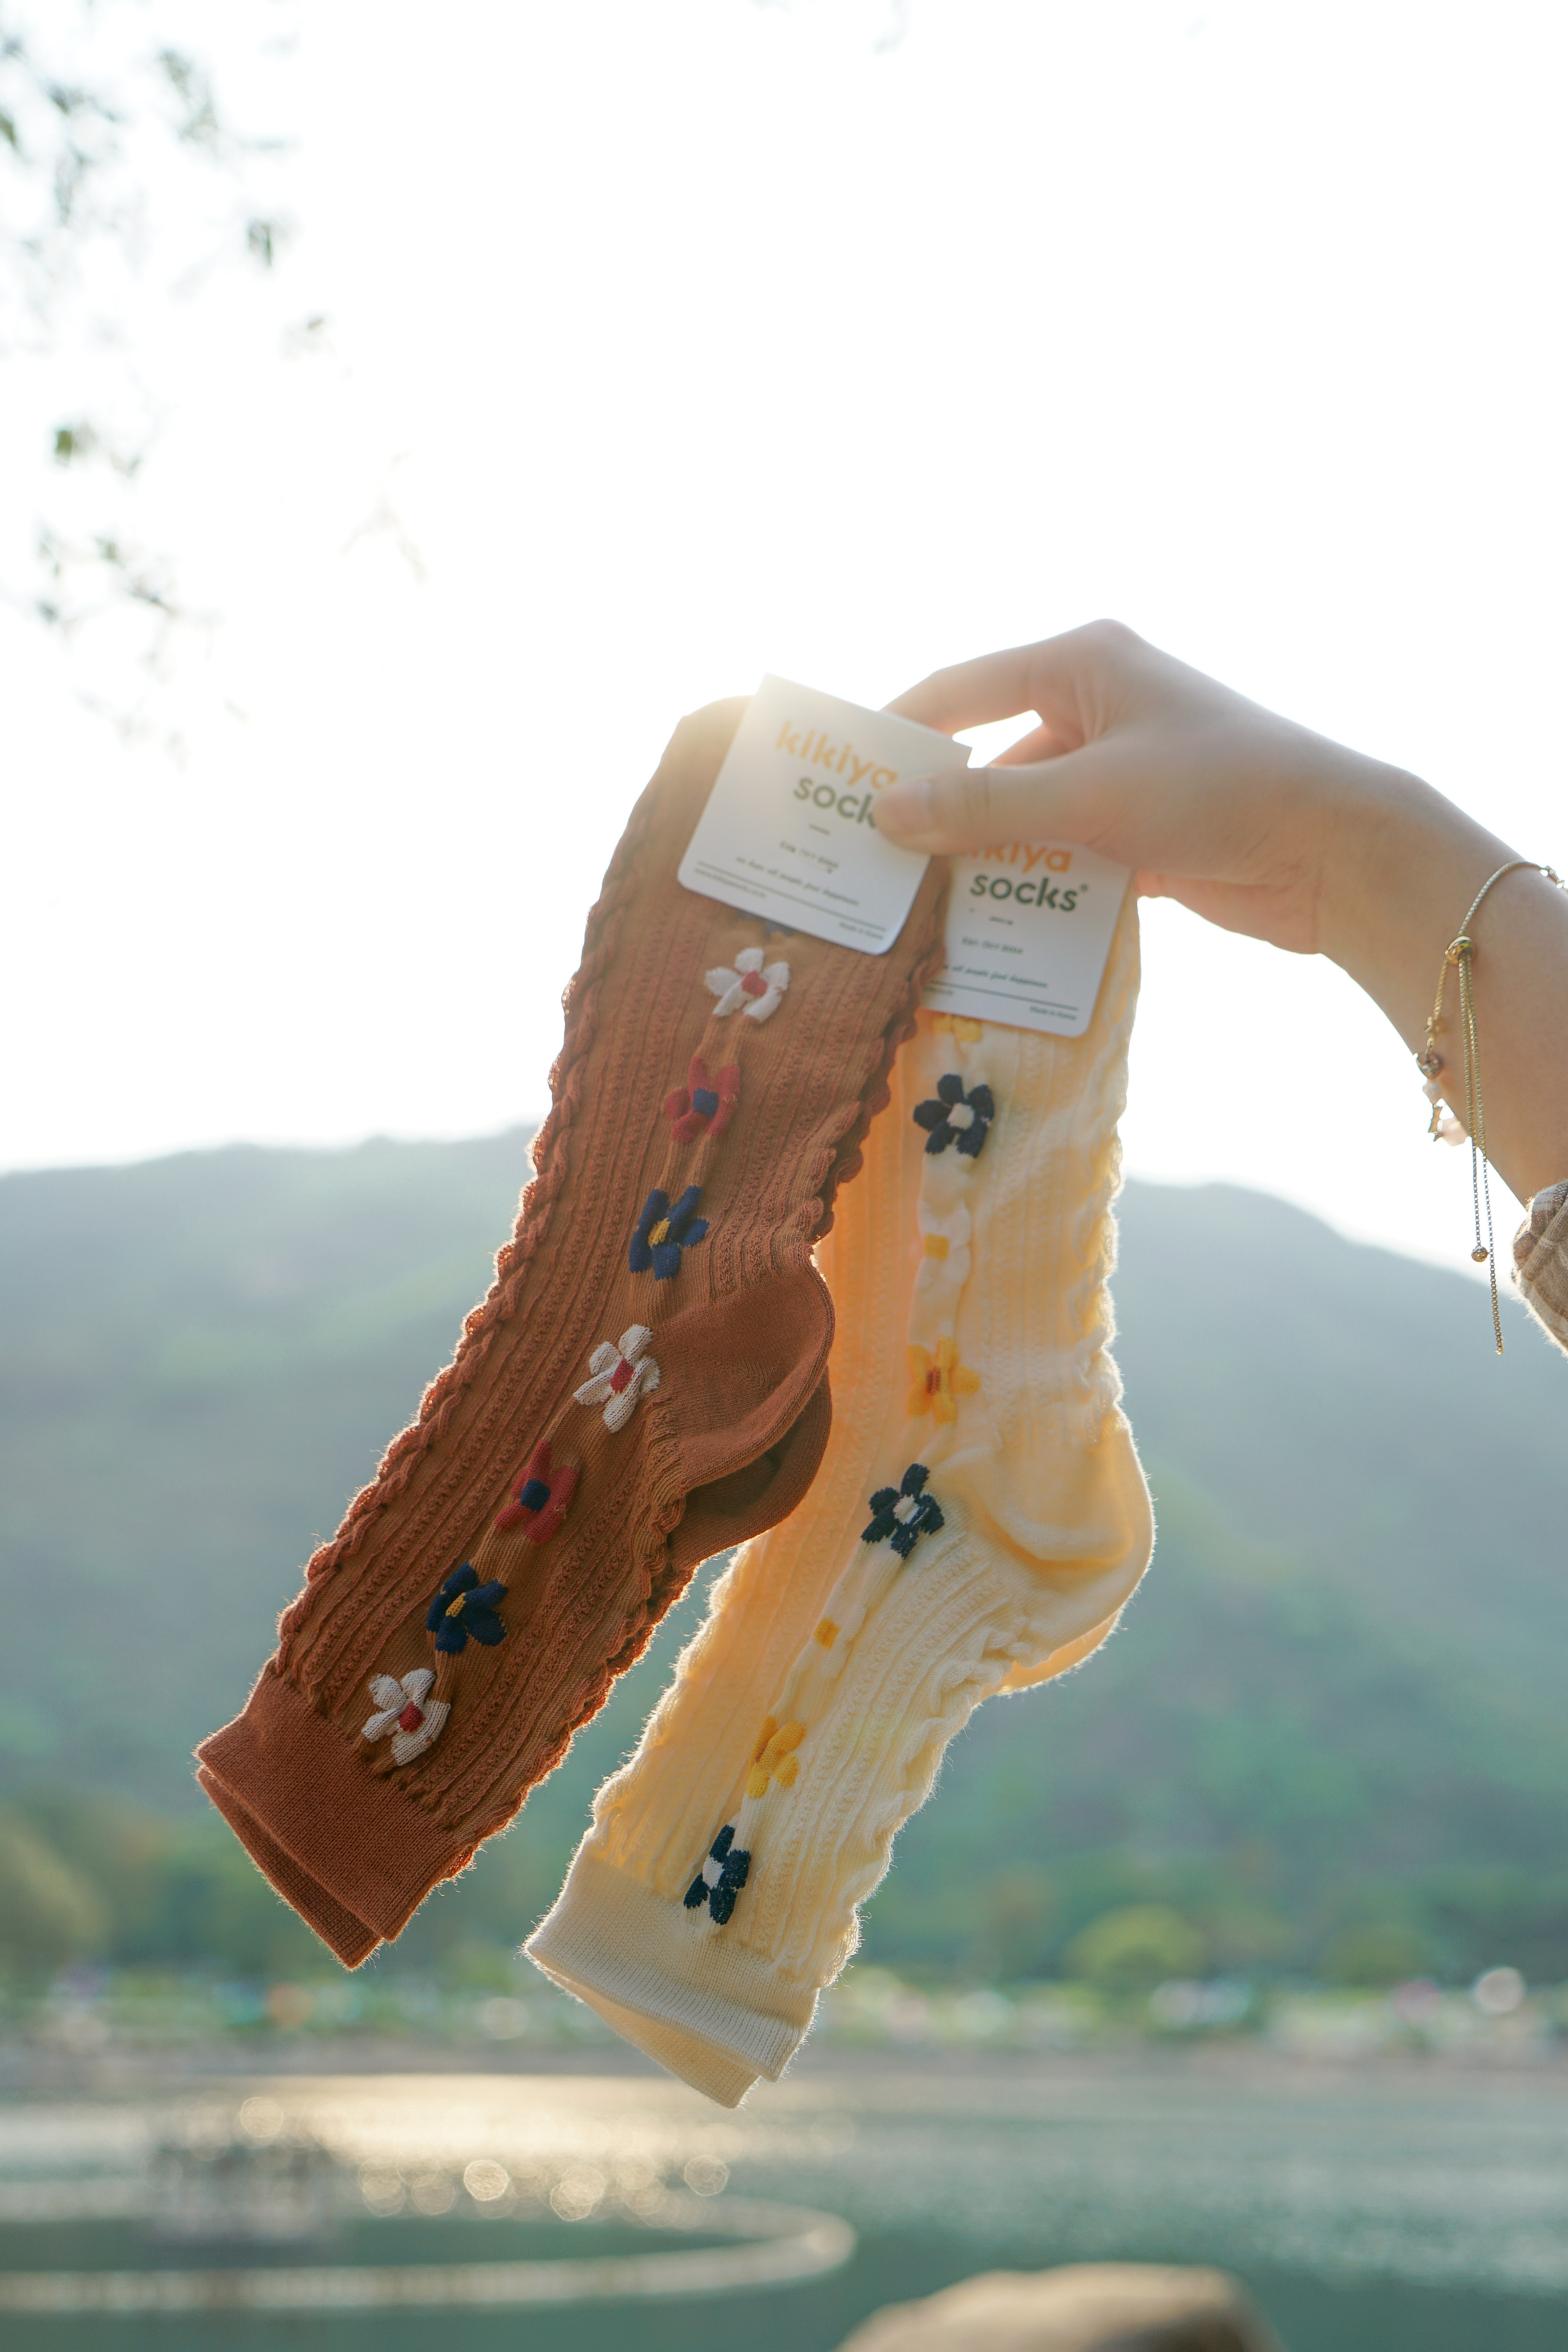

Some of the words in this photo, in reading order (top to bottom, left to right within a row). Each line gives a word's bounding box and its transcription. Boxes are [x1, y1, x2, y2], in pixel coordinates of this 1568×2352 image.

[775, 720, 899, 791] kikiya
[793, 776, 876, 829] sock
[970, 874, 1078, 911] socks
